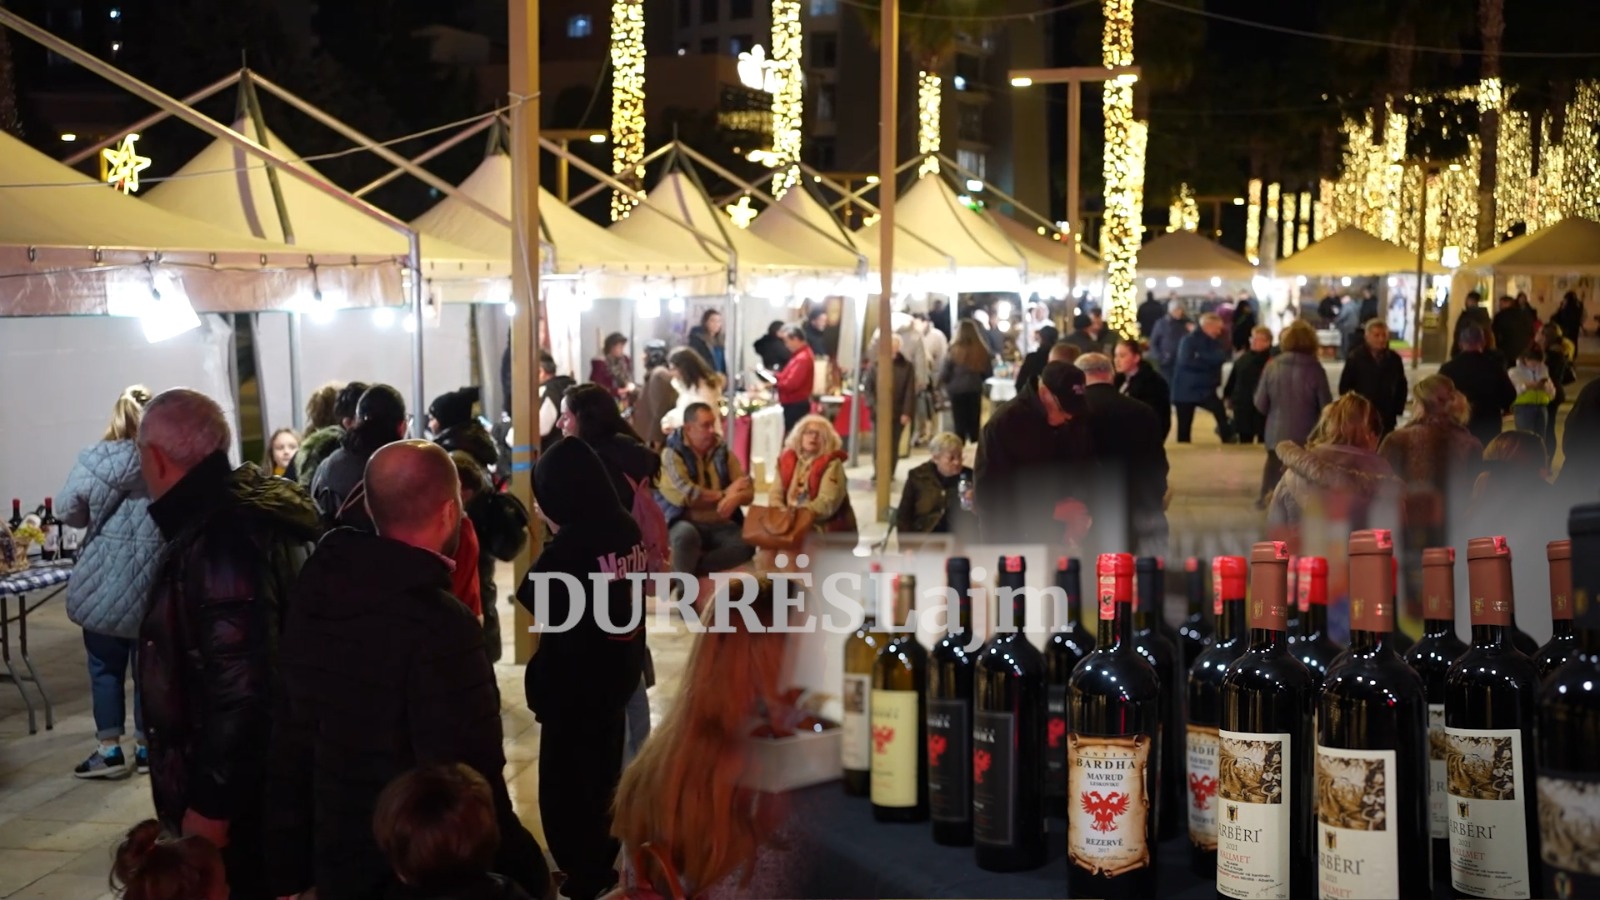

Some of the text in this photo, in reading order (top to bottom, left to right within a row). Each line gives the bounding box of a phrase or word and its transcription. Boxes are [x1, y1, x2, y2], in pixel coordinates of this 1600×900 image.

[597, 544, 647, 583] Marlb
[1076, 758, 1136, 770] BARDHA
[1087, 772, 1124, 781] MAVRUD
